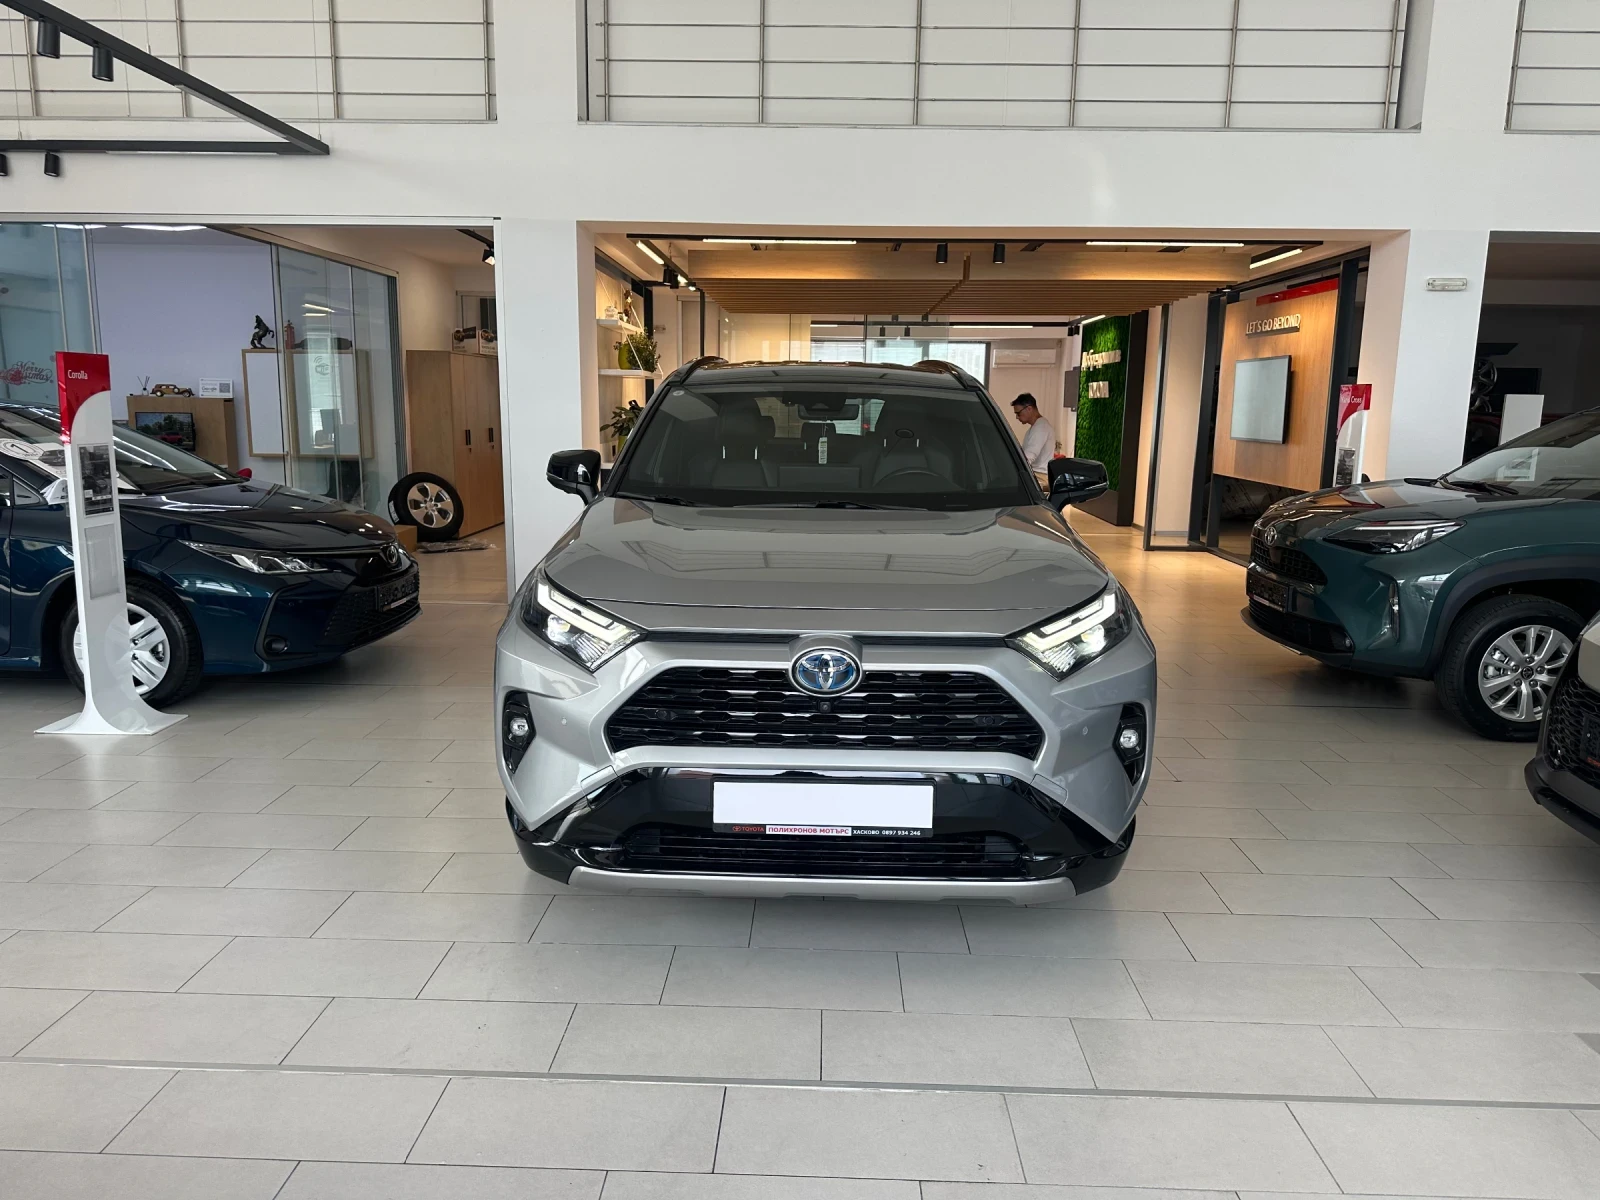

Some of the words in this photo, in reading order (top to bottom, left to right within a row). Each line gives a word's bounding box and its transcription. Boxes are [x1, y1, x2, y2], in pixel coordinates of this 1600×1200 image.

[1246, 320, 1261, 334] LET'S
[1262, 319, 1273, 332] GO
[1273, 314, 1300, 330] BEYOND
[67, 369, 88, 380] Corolla
[1350, 395, 1362, 404] Cross
[768, 826, 818, 834] ПОЛИХРОНОВ
